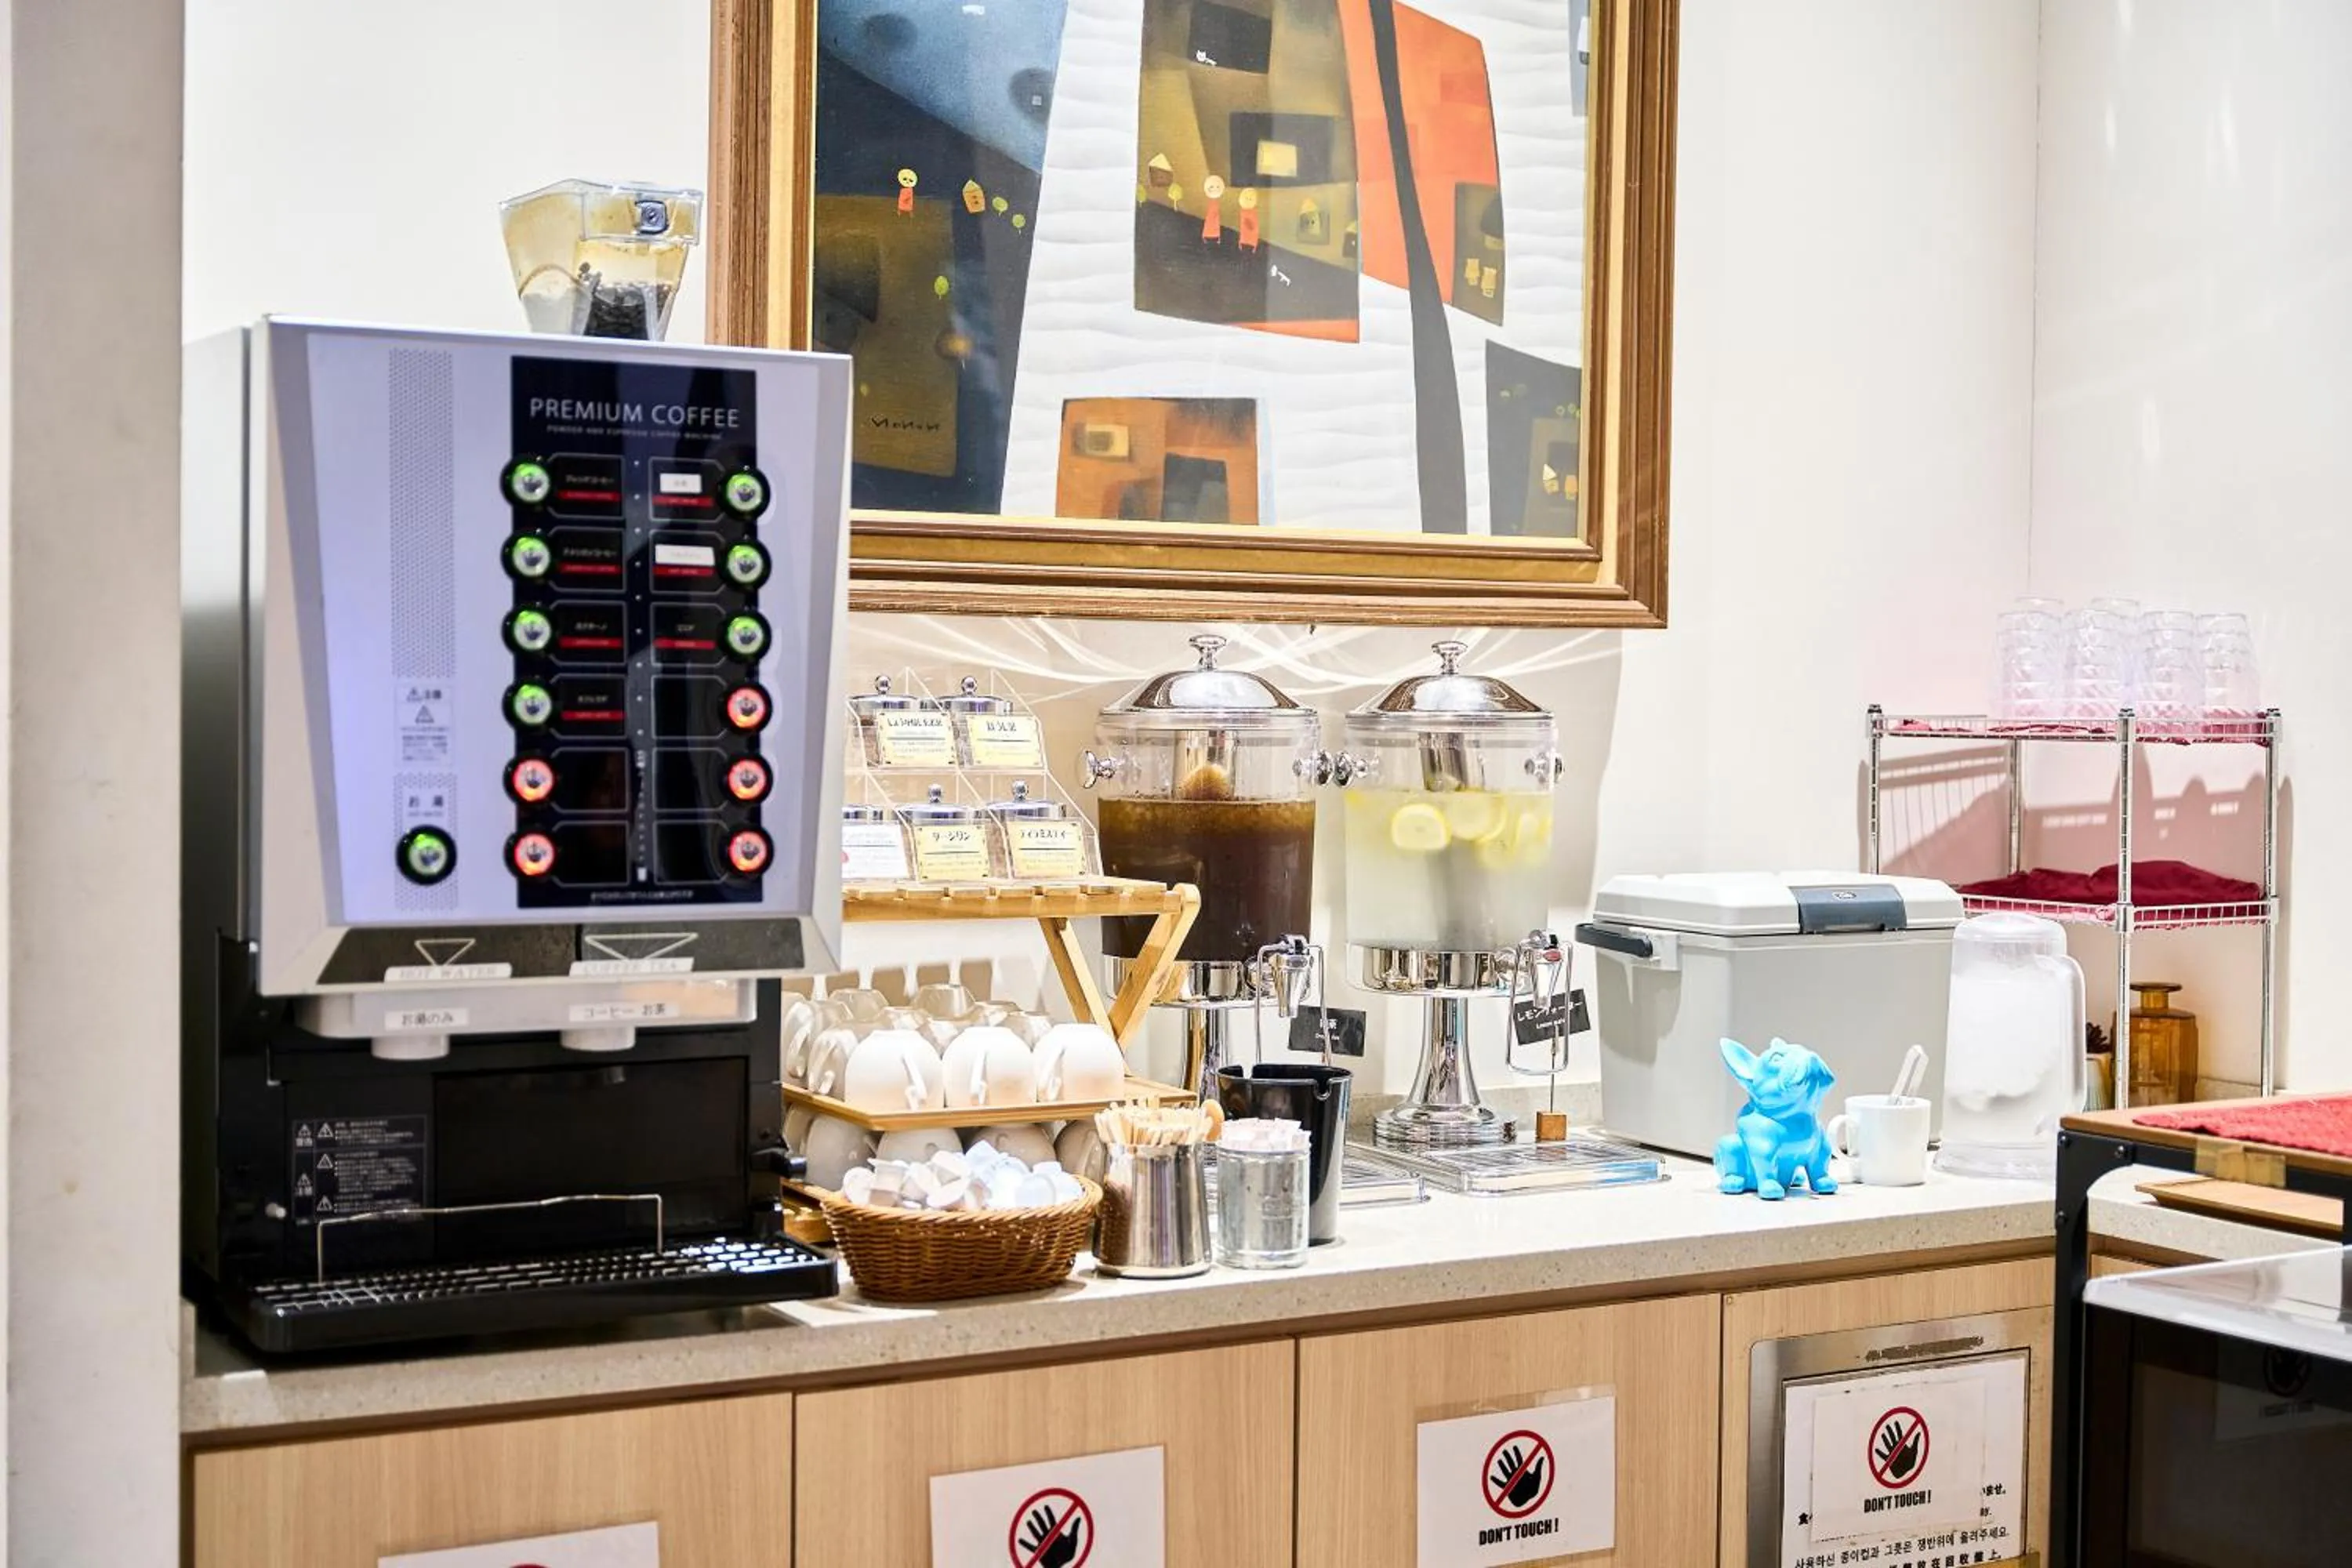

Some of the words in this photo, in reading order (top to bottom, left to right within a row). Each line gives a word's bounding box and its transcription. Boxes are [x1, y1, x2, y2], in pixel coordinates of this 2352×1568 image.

[530, 398, 643, 422] PREMIUM
[652, 405, 739, 427] COFFEE
[1864, 1496, 1893, 1513] DON'T
[1894, 1491, 1926, 1508] TOUCH
[1479, 1526, 1512, 1545] DON'T
[1515, 1519, 1552, 1539] TOUCH
[1795, 1551, 1835, 1568] 사용하신
[1884, 1541, 1912, 1555] 그릇은
